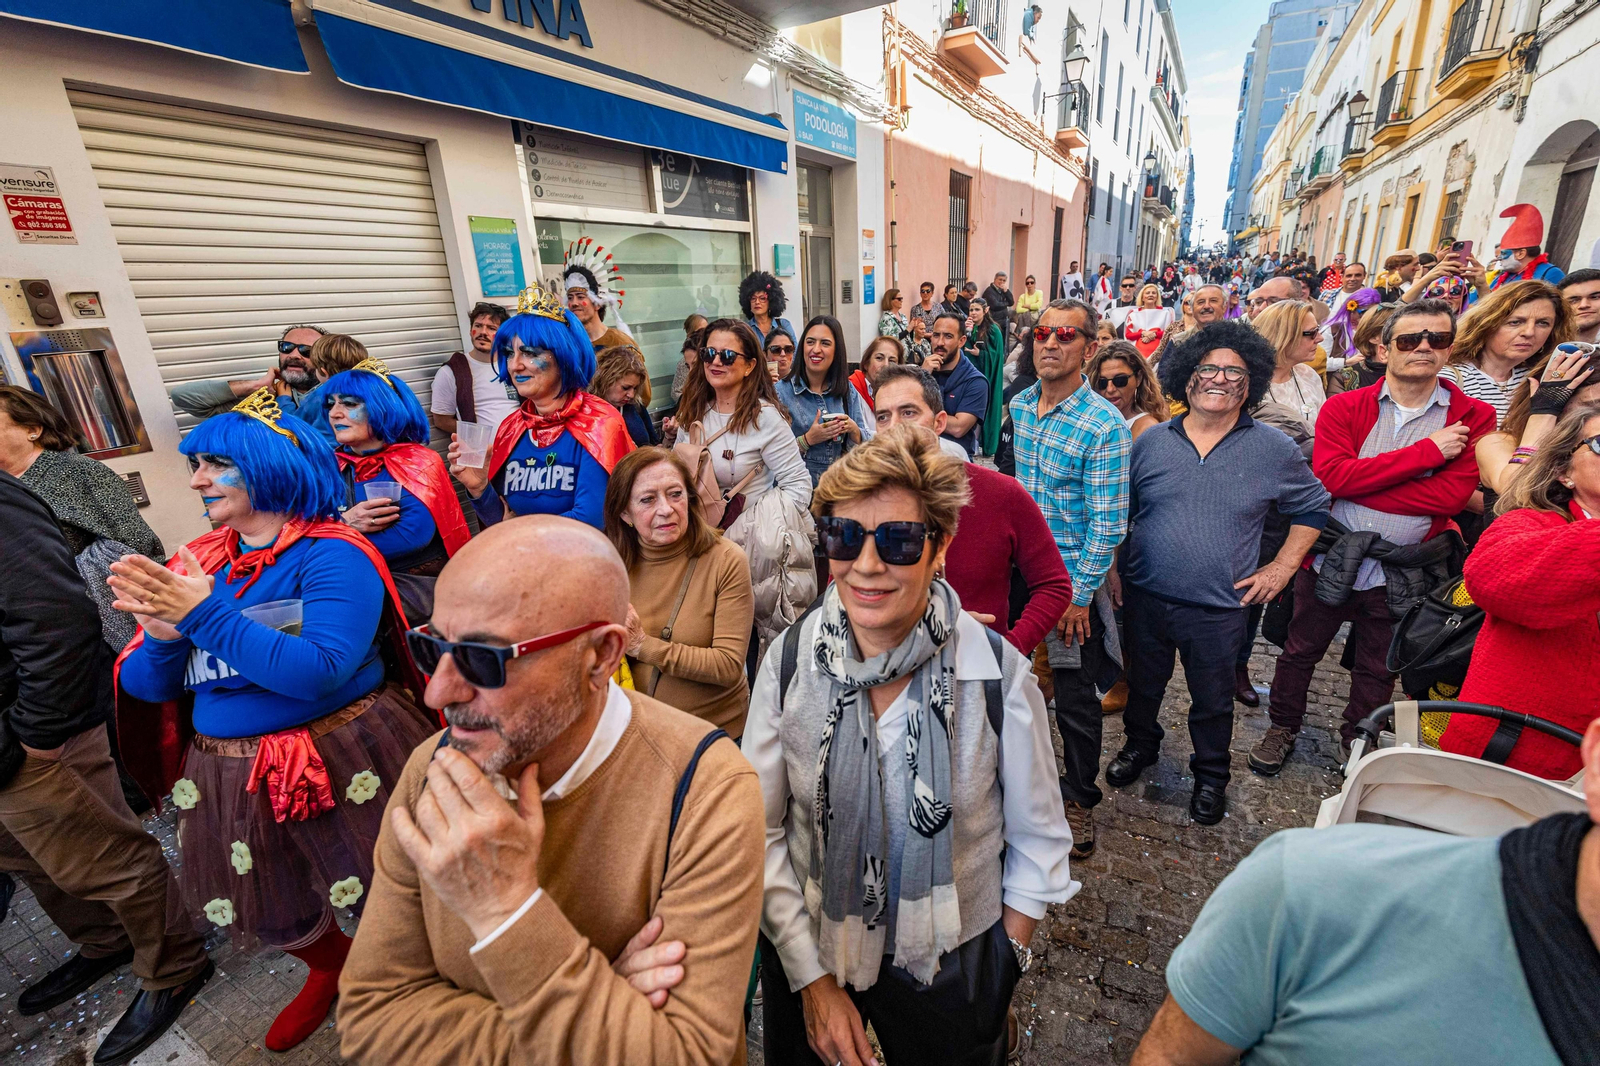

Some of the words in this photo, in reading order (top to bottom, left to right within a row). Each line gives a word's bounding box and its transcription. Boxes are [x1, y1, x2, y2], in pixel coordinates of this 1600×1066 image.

[804, 112, 849, 140] PODOLOGÍA
[802, 131, 813, 141] BAJO
[544, 173, 561, 181] Control
[0, 178, 54, 188] verisure
[545, 190, 584, 200] Dermocosmética
[7, 197, 62, 209] Cámaras
[483, 242, 511, 250] HORARIO
[1105, 312, 1110, 320] A
